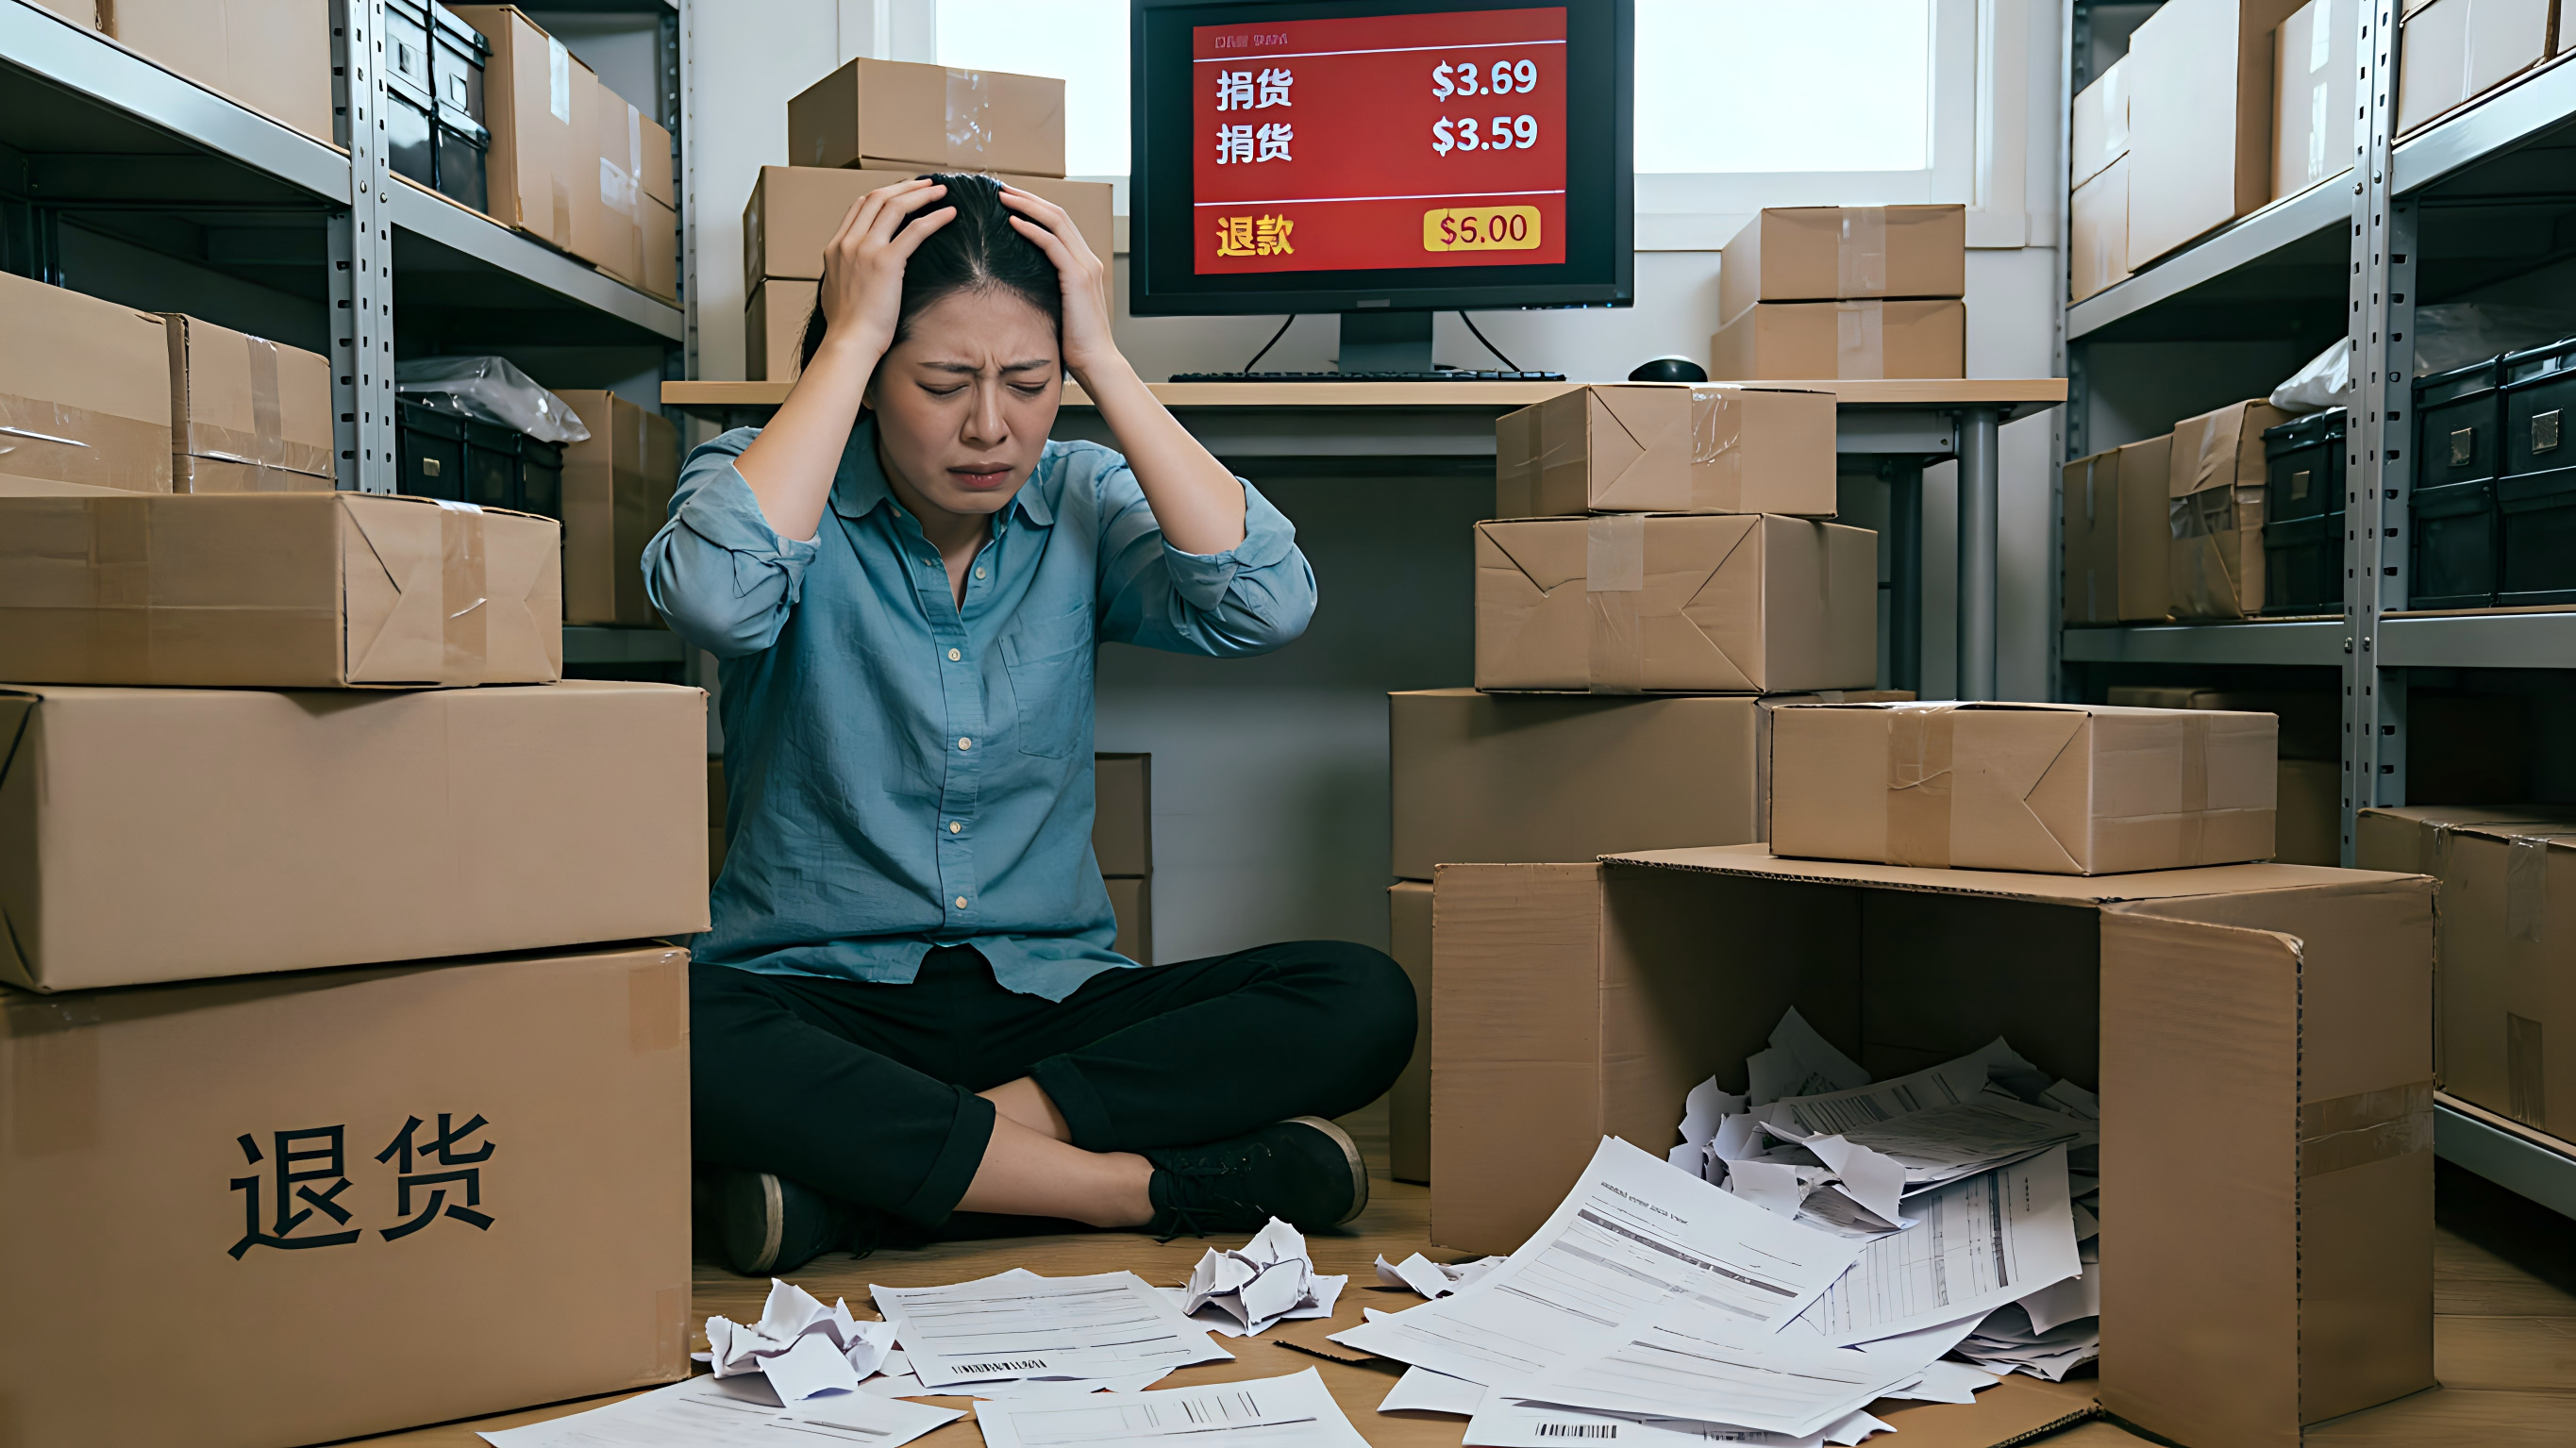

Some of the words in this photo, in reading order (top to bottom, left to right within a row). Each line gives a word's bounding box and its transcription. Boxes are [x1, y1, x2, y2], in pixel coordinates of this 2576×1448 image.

[1432, 59, 1538, 102] $3.69
[1432, 114, 1538, 157] $3.59
[1216, 214, 1296, 258] 退款
[1440, 215, 1528, 247] $5.00
[227, 1113, 496, 1261] 退货
